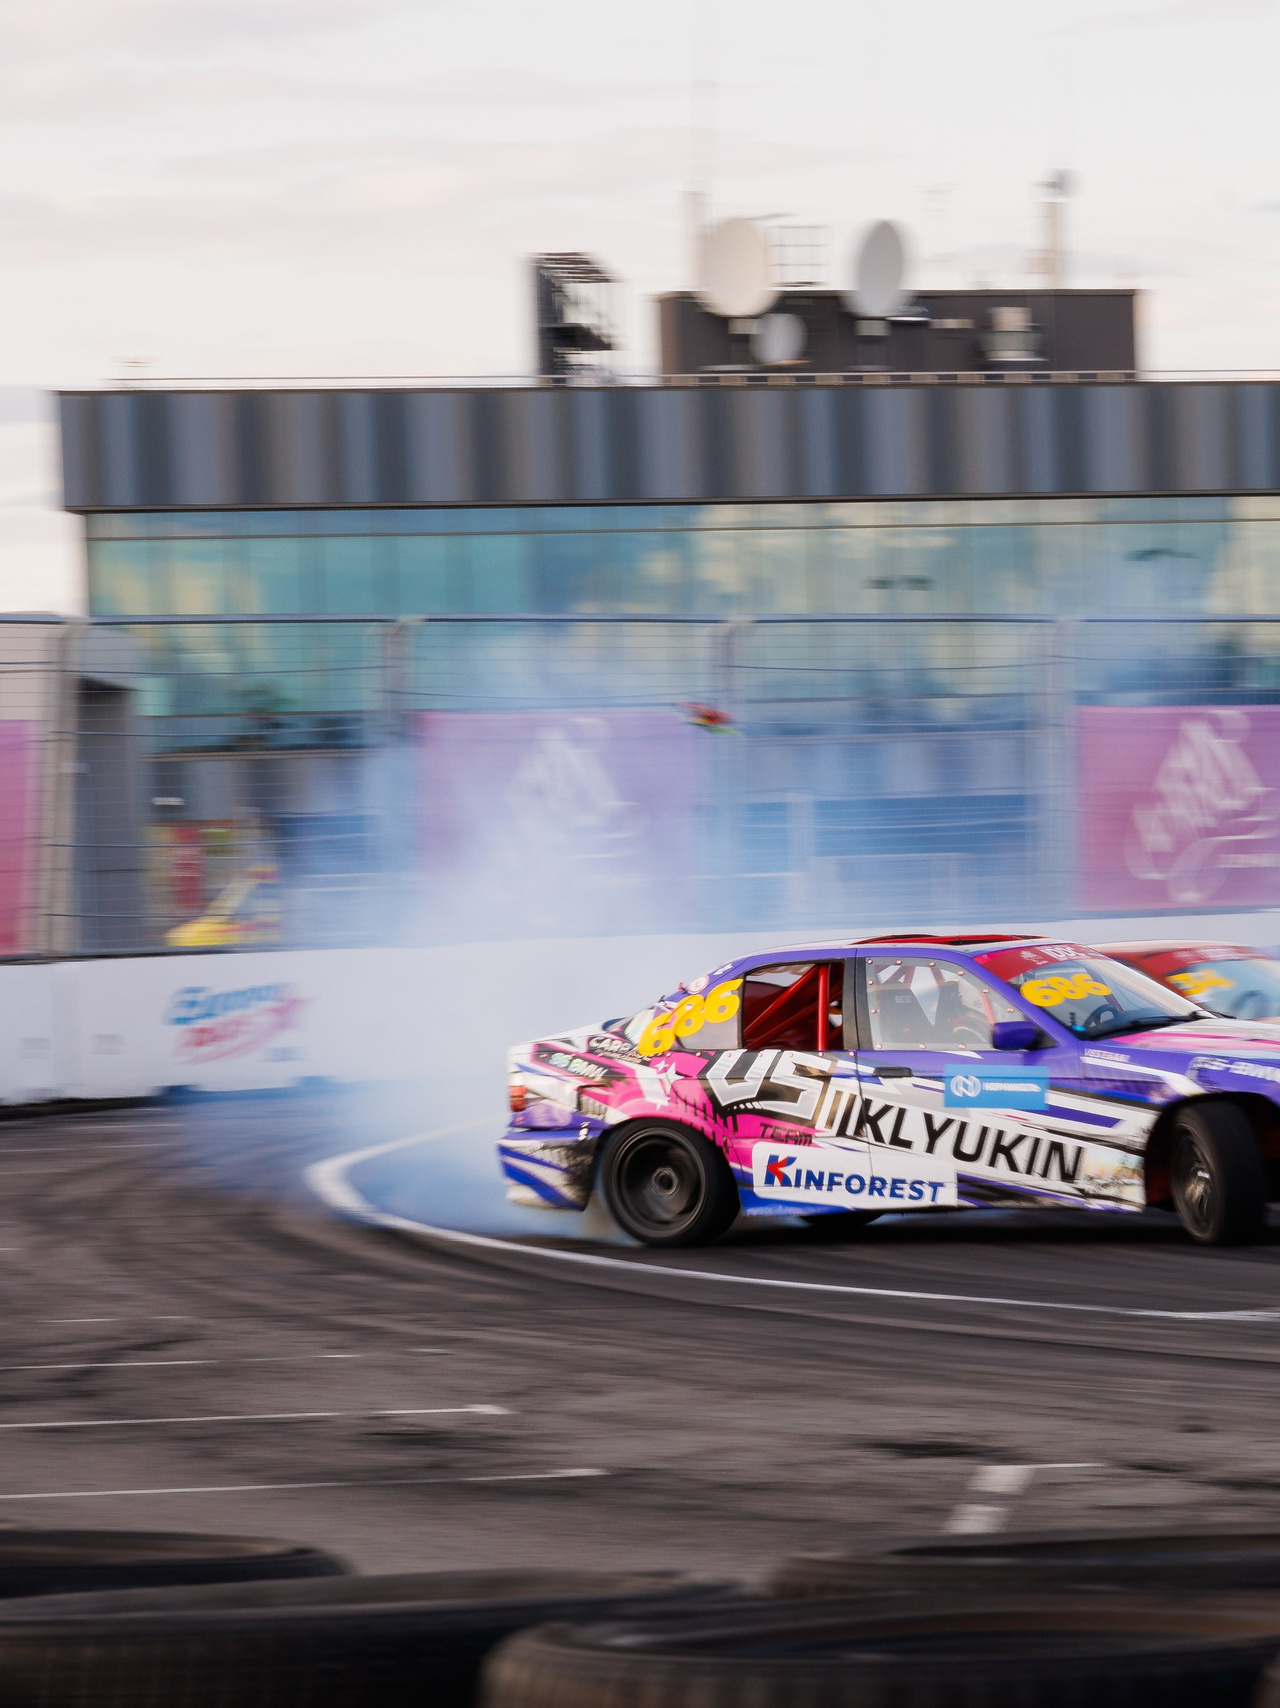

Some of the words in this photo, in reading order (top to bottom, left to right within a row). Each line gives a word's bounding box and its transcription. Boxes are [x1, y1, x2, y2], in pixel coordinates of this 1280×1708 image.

[1021, 973, 1112, 1007] 686
[638, 979, 743, 1056] 686
[763, 1154, 945, 1202] KINFOREST
